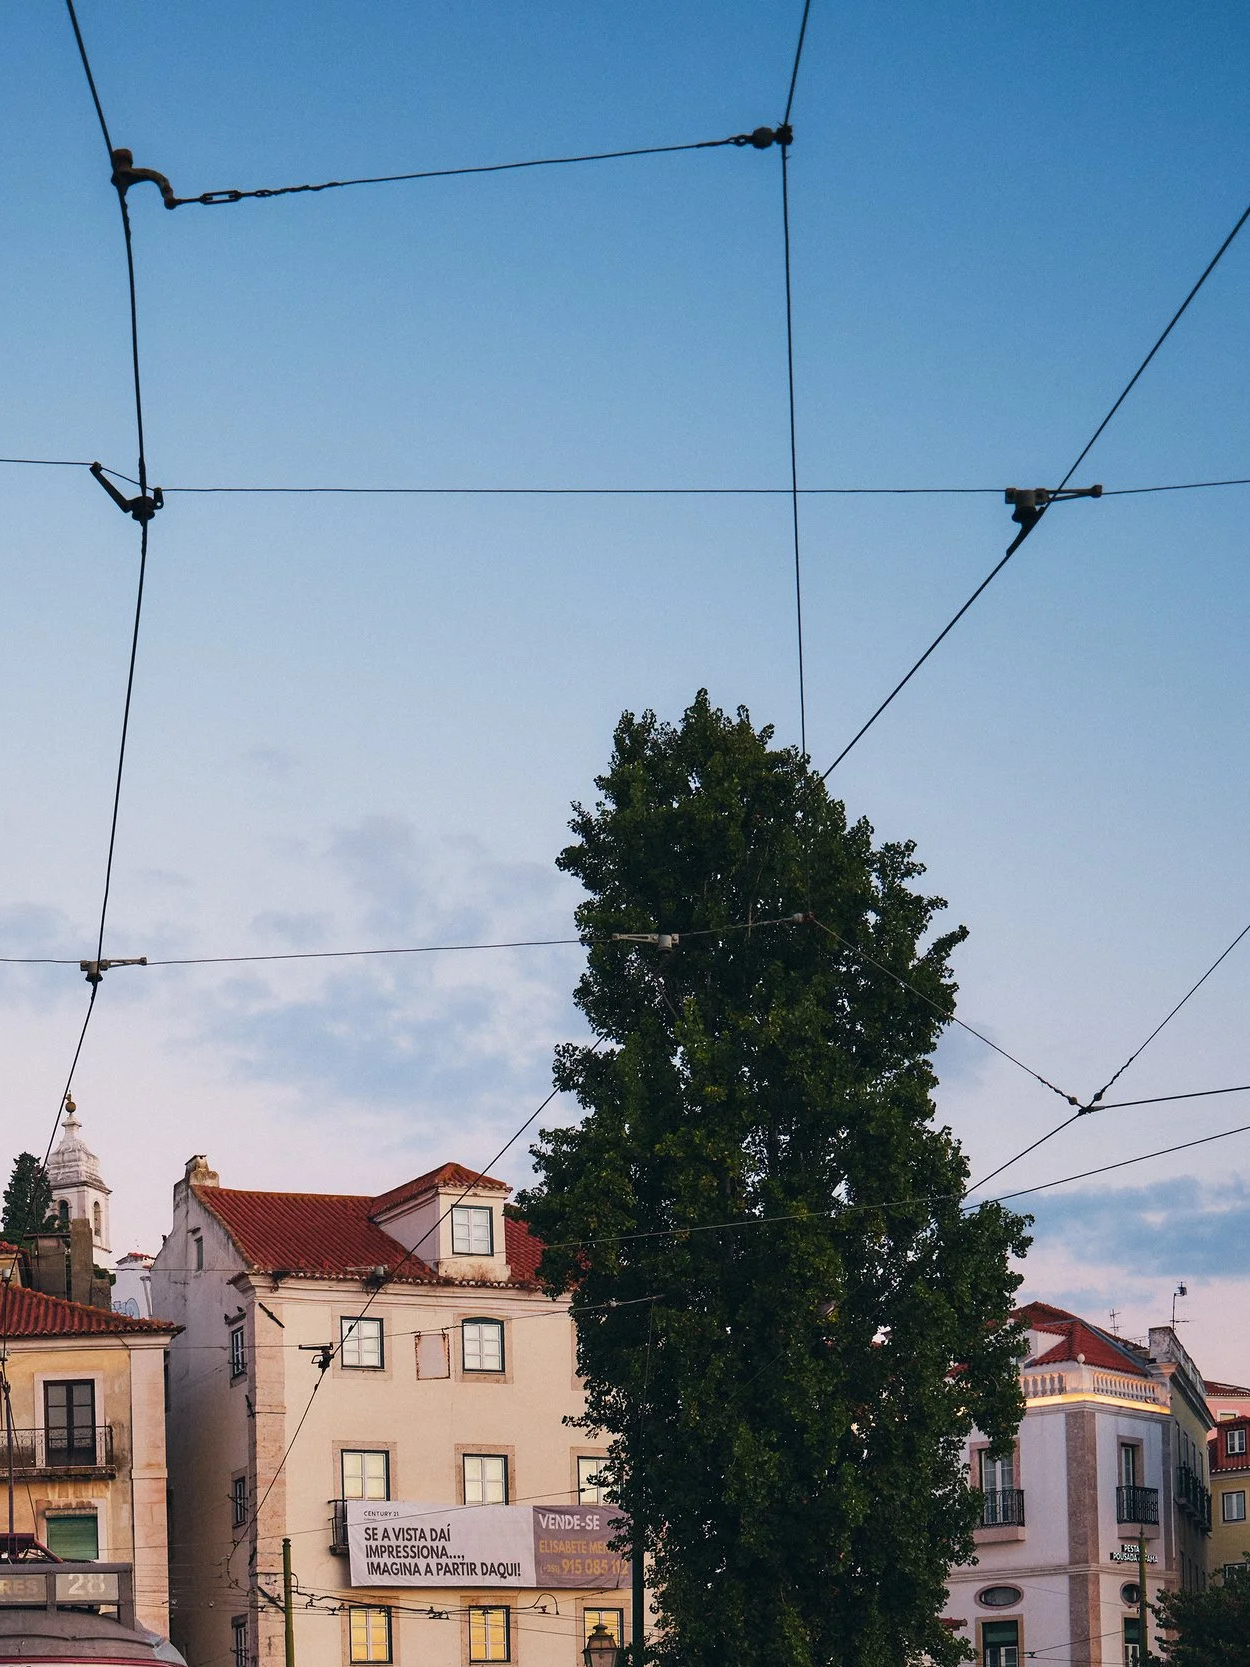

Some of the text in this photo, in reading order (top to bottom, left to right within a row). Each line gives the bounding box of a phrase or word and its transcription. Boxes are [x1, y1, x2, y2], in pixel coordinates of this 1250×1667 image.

[538, 1514, 600, 1530] VENDE-SE
[364, 1524, 451, 1542] SE A VISTA DAÍ
[365, 1544, 465, 1560] IMPRESSIONA...,
[539, 1540, 588, 1554] ELISABETE
[366, 1562, 521, 1579] IMAGINA A PARTIR DAQUI!
[561, 1558, 583, 1574] 915
[584, 1559, 609, 1575] 085
[611, 1559, 629, 1576] 112
[67, 1573, 106, 1595] 28
